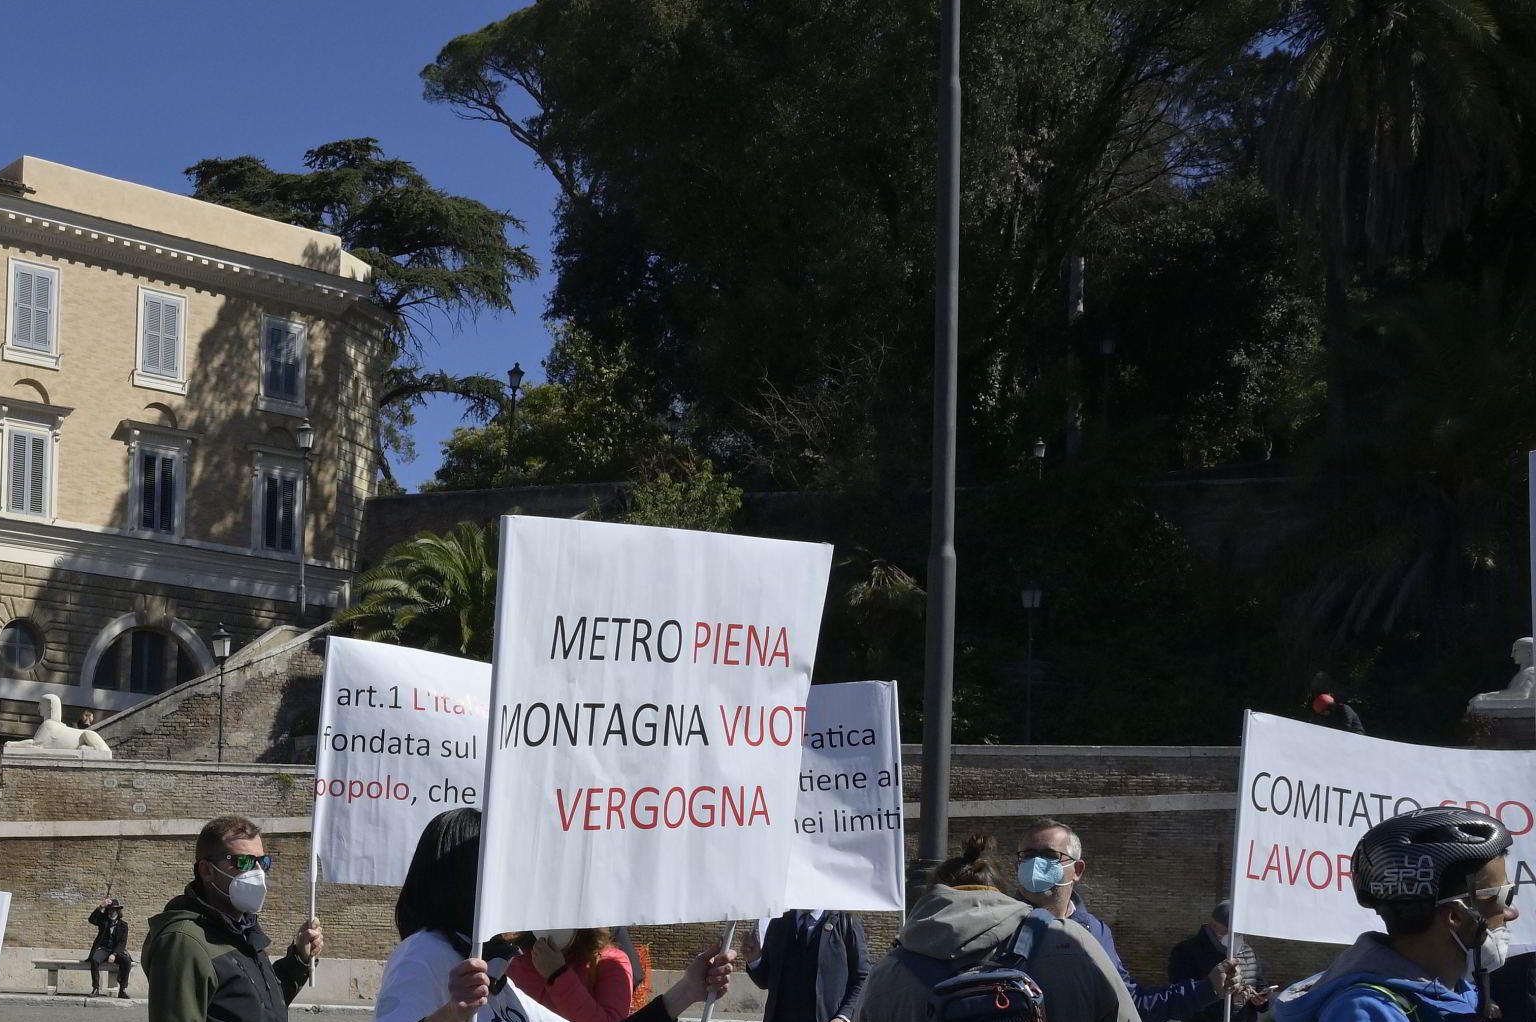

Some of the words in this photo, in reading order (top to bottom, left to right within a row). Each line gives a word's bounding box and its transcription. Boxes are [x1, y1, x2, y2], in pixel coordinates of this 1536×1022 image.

[550, 615, 683, 663] METRO
[693, 621, 790, 667] PIENA
[337, 685, 402, 709] art.1
[499, 702, 709, 750] MONTAGNA
[323, 726, 430, 757] fondata
[440, 735, 477, 760] sul
[877, 762, 899, 788] al
[315, 775, 417, 806] popolo,
[428, 778, 477, 804] che
[556, 785, 771, 831] VERGOGNA
[834, 807, 901, 832] limiti
[1383, 868, 1434, 881] SPO
[1404, 855, 1434, 868] LA
